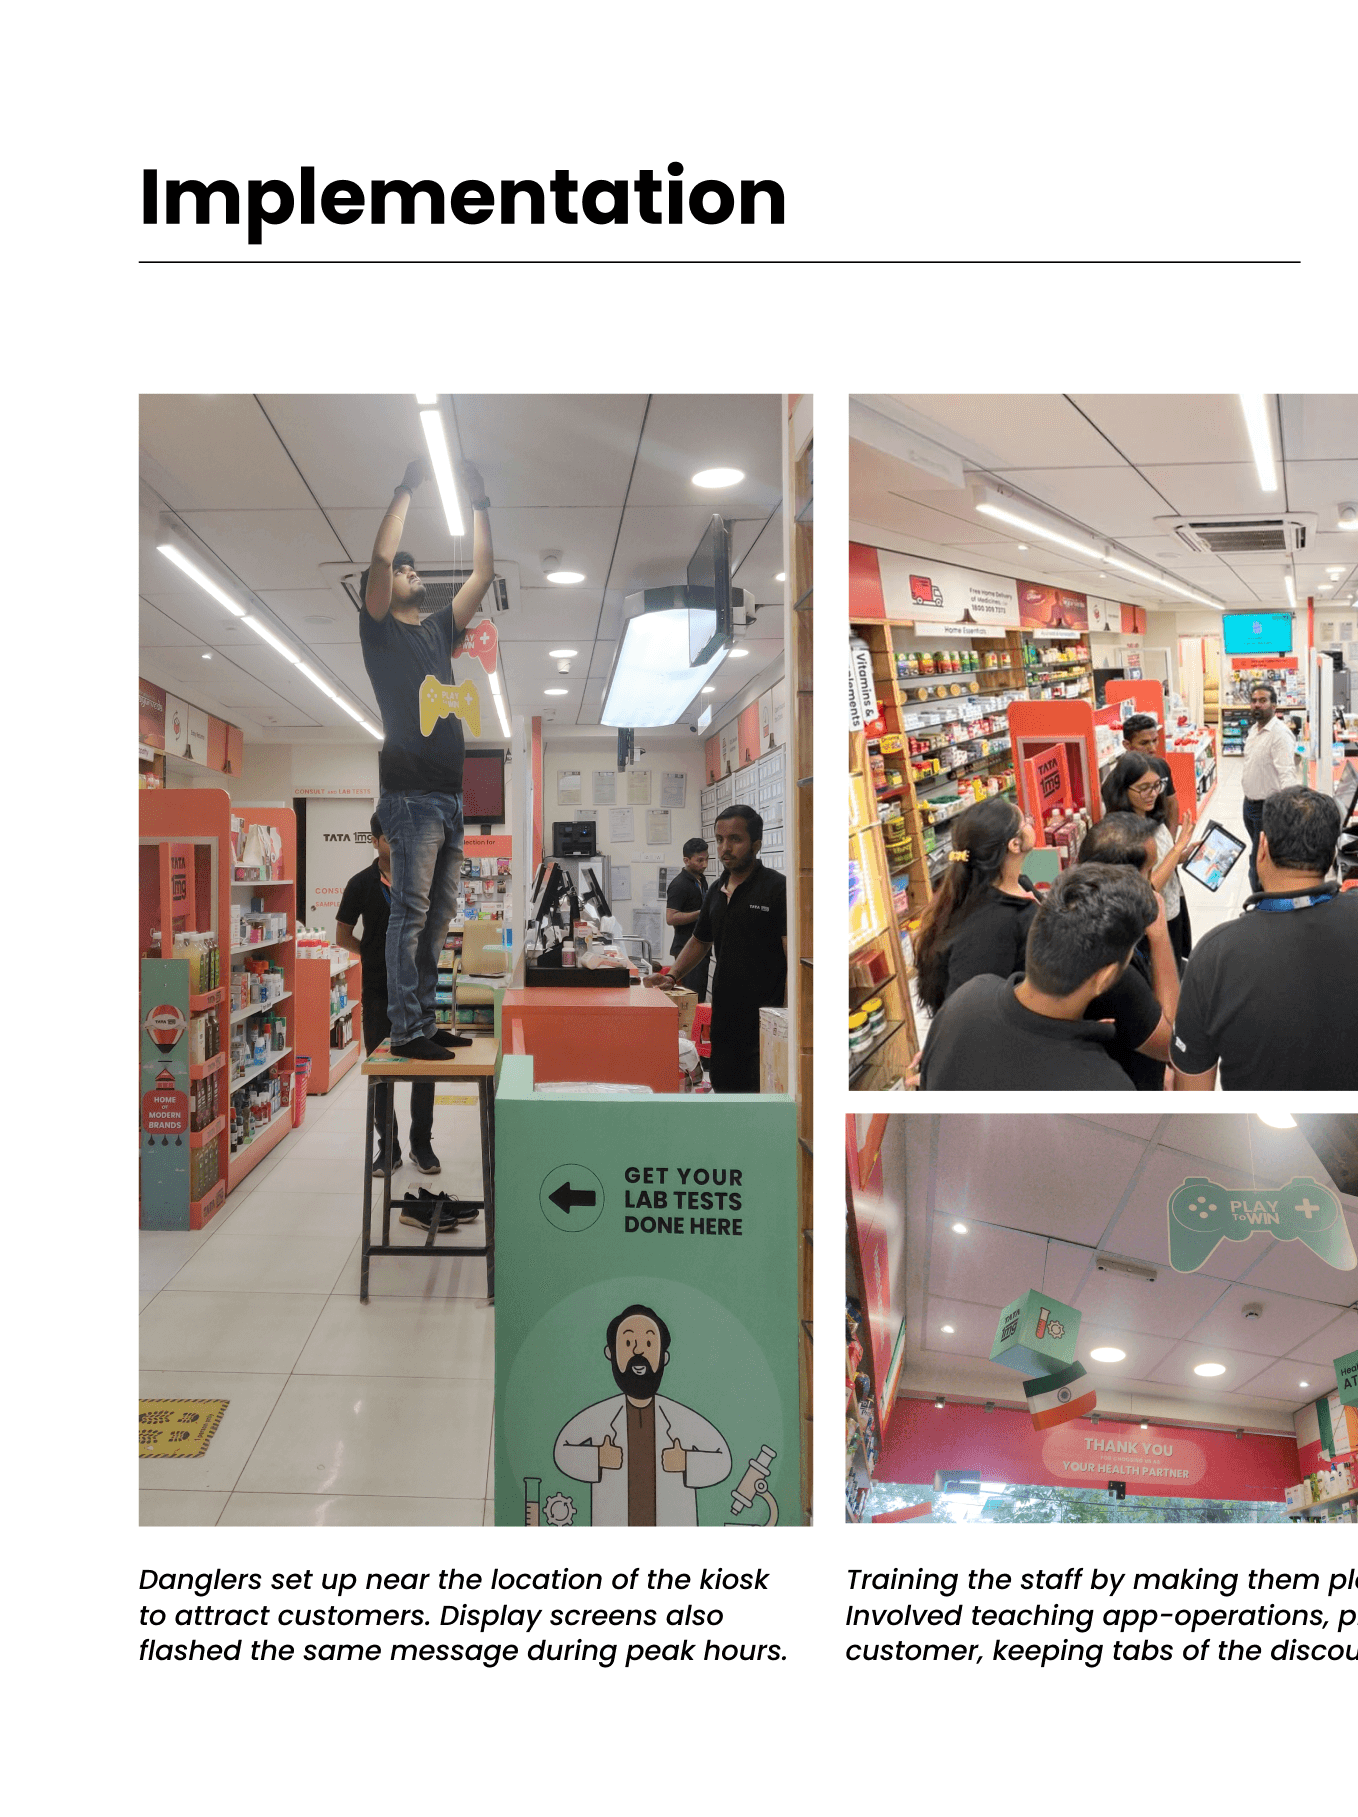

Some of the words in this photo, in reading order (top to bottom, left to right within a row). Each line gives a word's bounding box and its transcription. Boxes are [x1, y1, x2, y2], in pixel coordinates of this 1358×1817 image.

[856, 653, 871, 706] Vitamins
[865, 708, 875, 717] &
[1037, 758, 1058, 775] TATA
[322, 833, 351, 842] TATA
[171, 856, 186, 869] TATA
[315, 887, 343, 895] CONSU
[154, 1096, 176, 1104] HOME
[148, 1111, 182, 1119] MODERN
[148, 1121, 182, 1129] BRANDS
[624, 1166, 669, 1185] GET
[676, 1167, 743, 1187] YOUR
[624, 1189, 668, 1209] LAB
[673, 1191, 743, 1211] TESTS
[1229, 1200, 1279, 1213] PLAY
[1246, 1212, 1280, 1225] WIN
[624, 1215, 685, 1235] DONE
[690, 1217, 743, 1236] HERE
[1004, 1308, 1020, 1324] TATA
[1084, 1437, 1139, 1454] THANK
[1142, 1442, 1174, 1457] YOU
[1113, 1456, 1143, 1464] CHOOSING
[1062, 1460, 1095, 1472] YOUR
[1097, 1463, 1140, 1476] HEALTH
[1142, 1466, 1190, 1479] PARTNER
